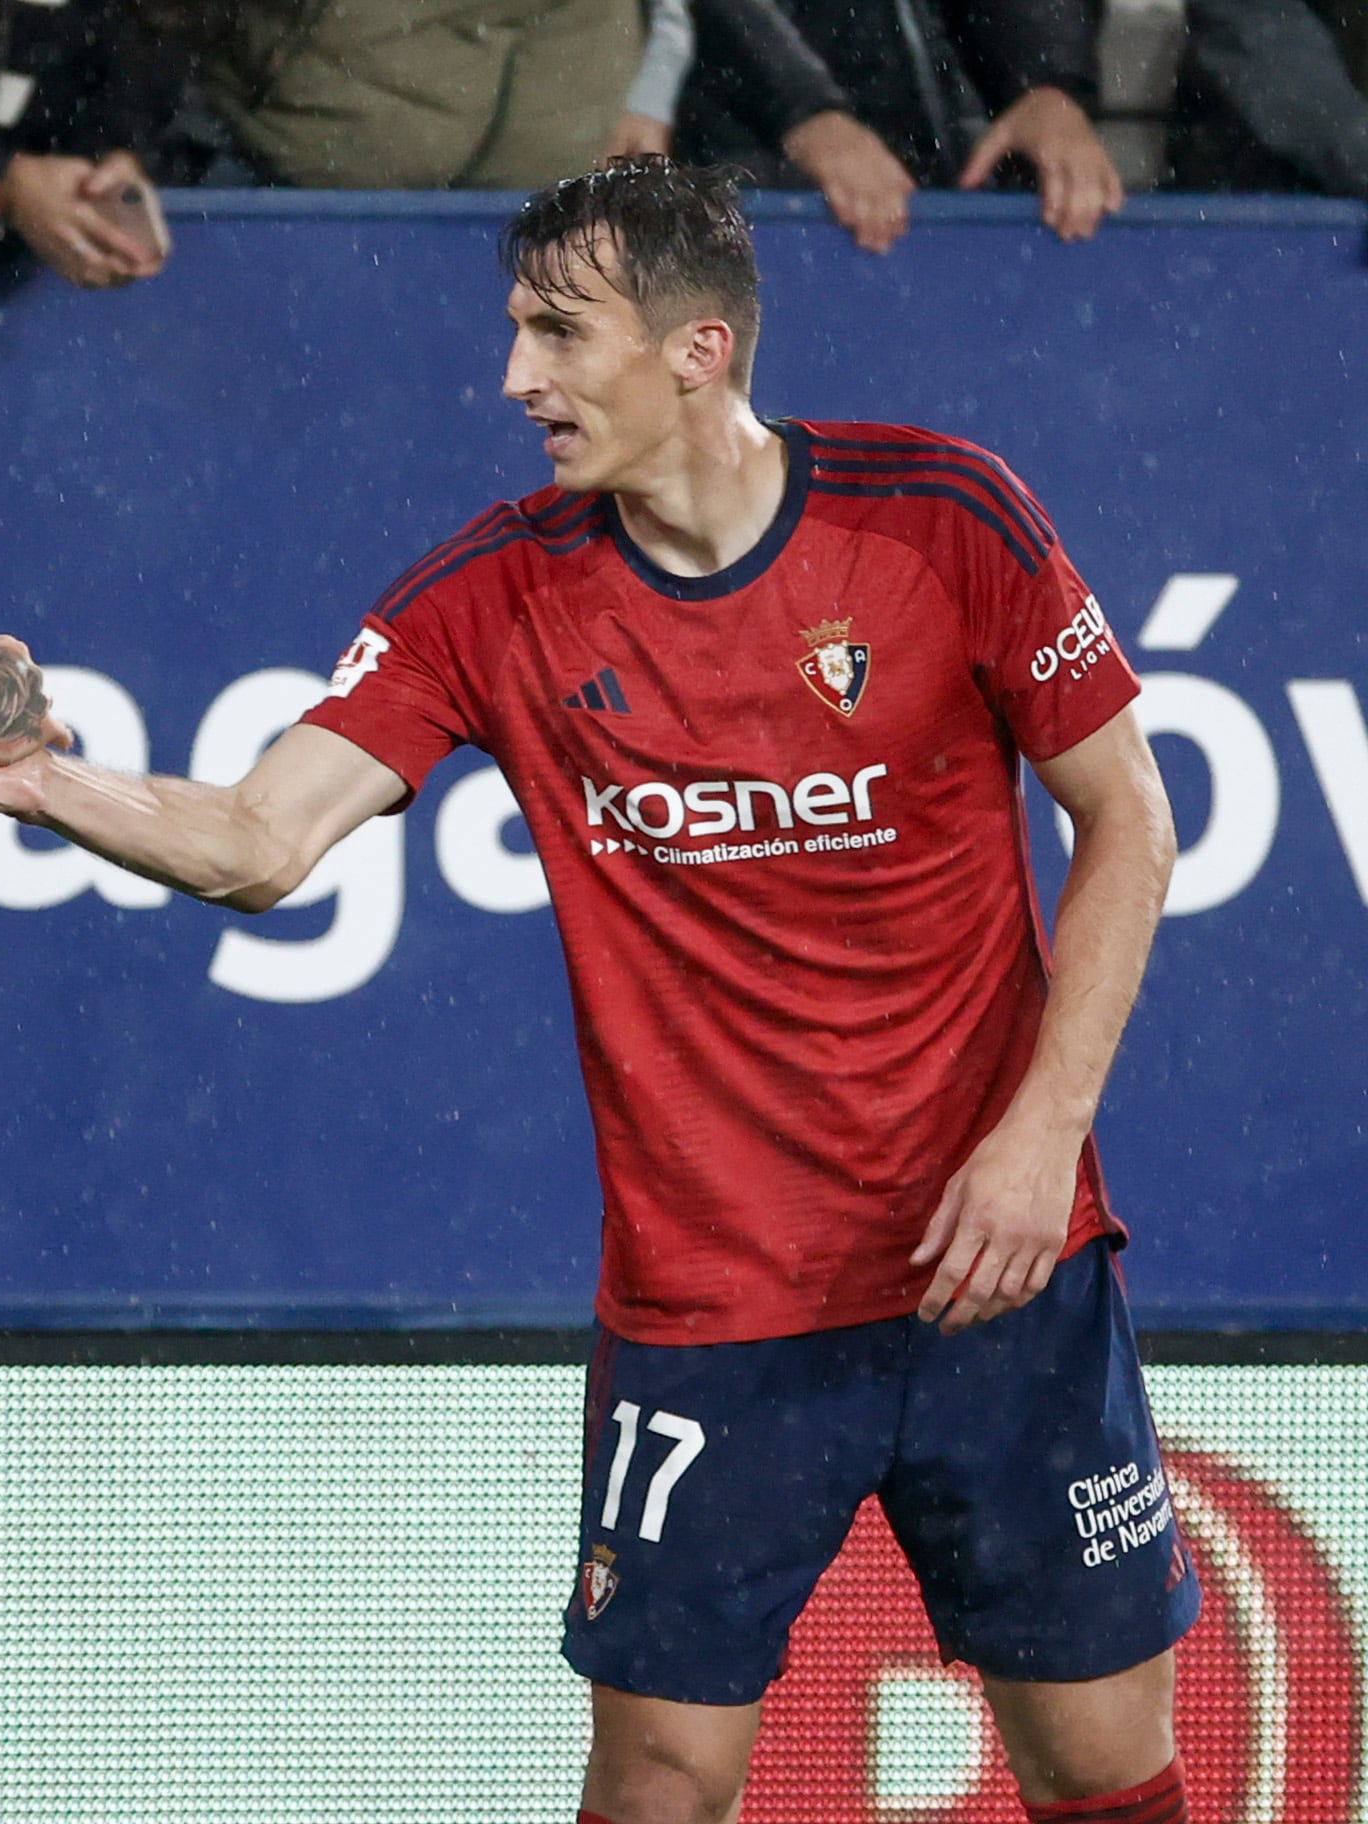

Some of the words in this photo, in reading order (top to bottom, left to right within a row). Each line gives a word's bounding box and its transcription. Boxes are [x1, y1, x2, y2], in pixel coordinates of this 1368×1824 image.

[653, 838, 799, 866] Climatización
[804, 827, 897, 853] eficiente
[601, 1400, 706, 1543] 17
[1068, 1462, 1139, 1509] Clínica
[1083, 1538, 1116, 1567] de
